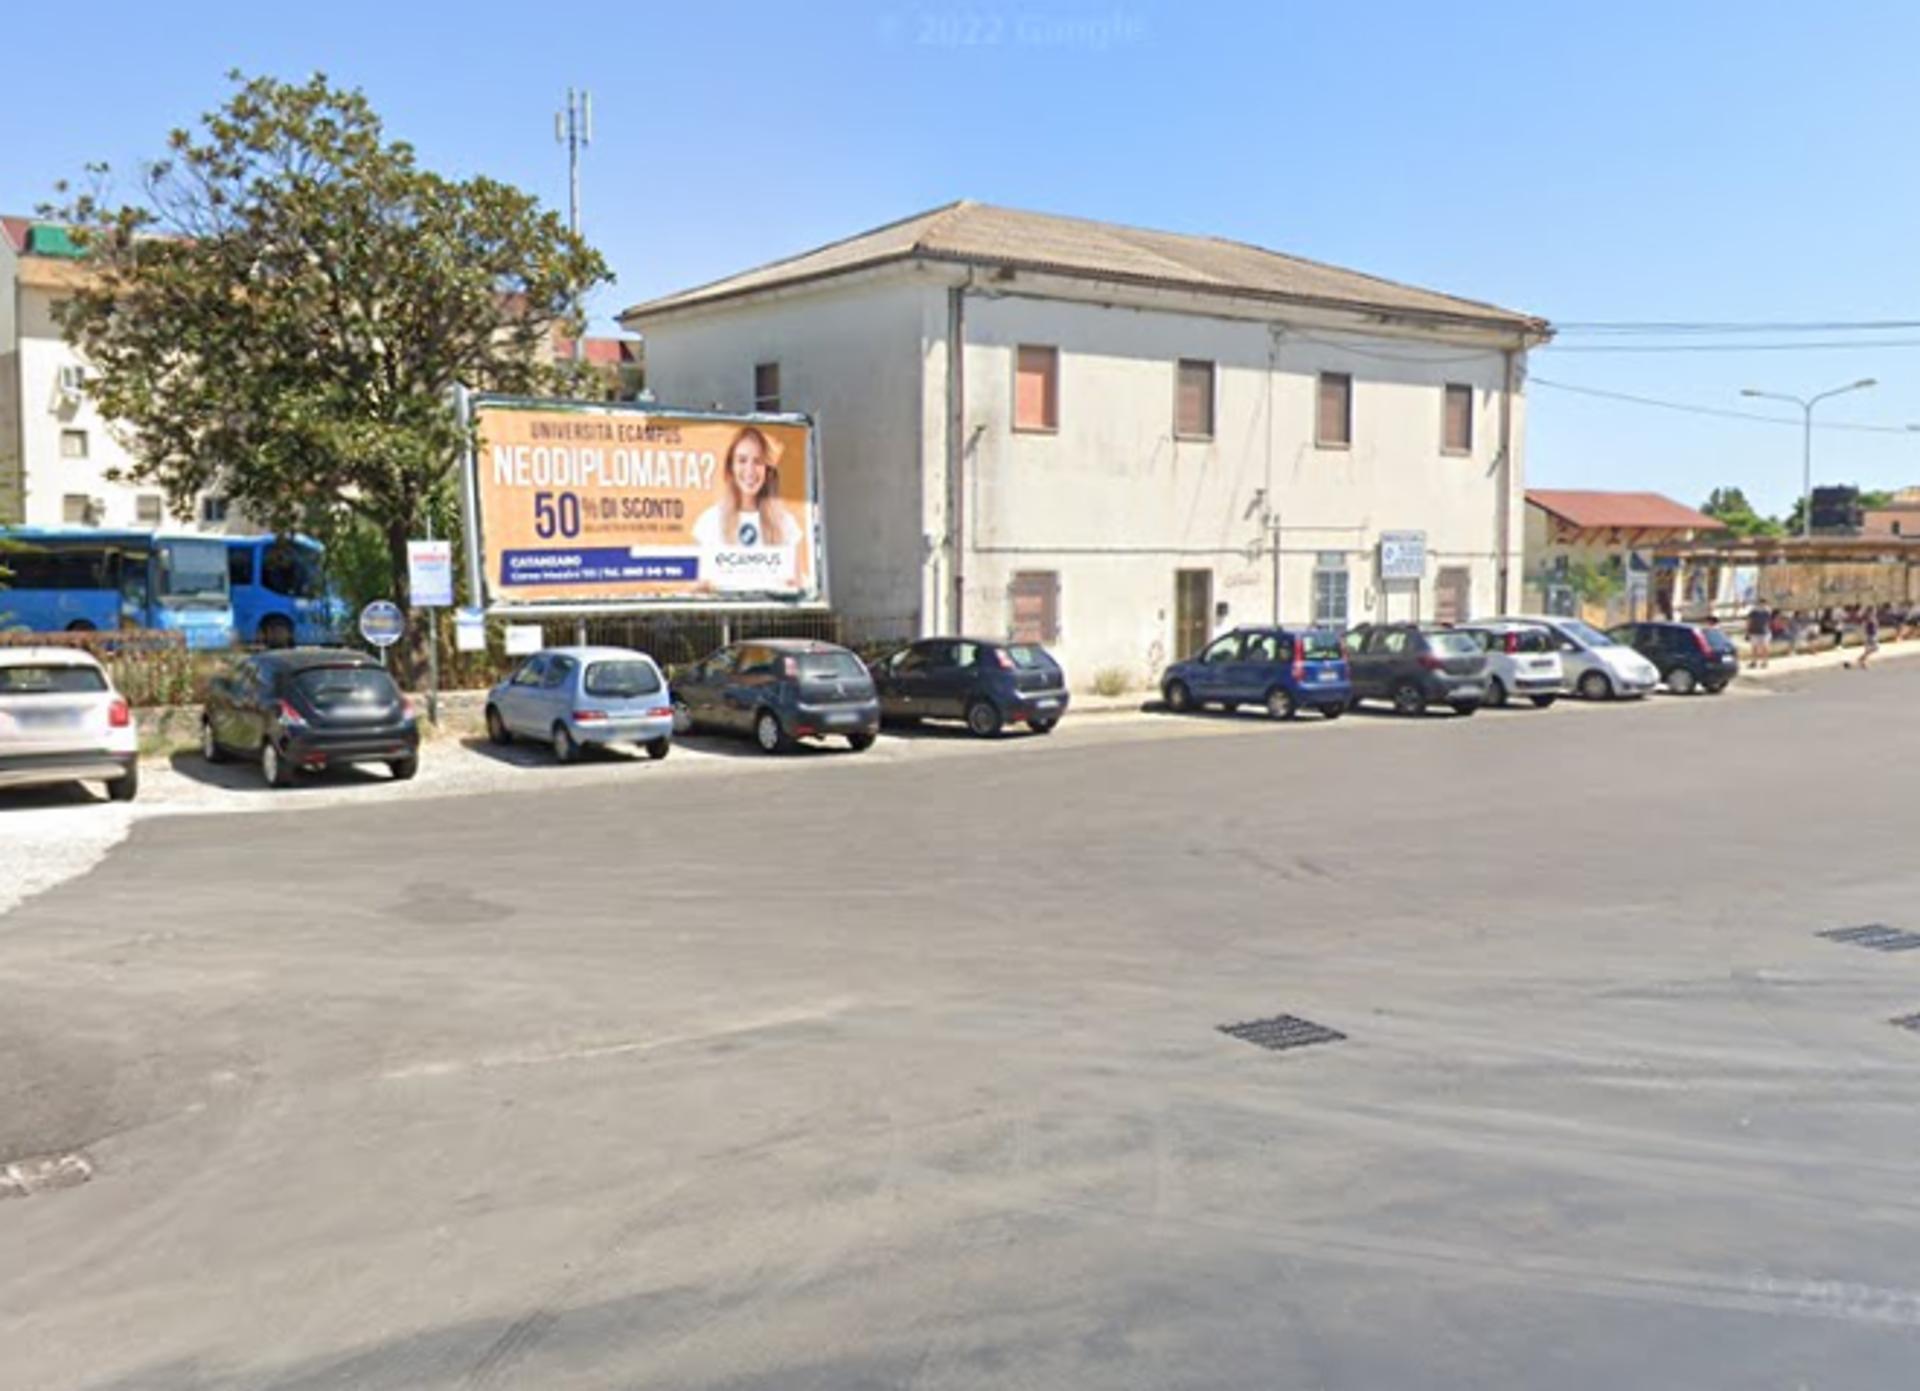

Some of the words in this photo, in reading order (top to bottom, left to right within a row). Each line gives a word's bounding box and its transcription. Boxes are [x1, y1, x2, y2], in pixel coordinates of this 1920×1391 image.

[617, 424, 682, 444] ECAMPUS
[494, 446, 716, 490] NEODIPLOMATA?
[534, 491, 580, 539] 50
[600, 497, 618, 519] DI
[622, 497, 684, 519] SCONTO
[510, 555, 582, 568] CATANZARO
